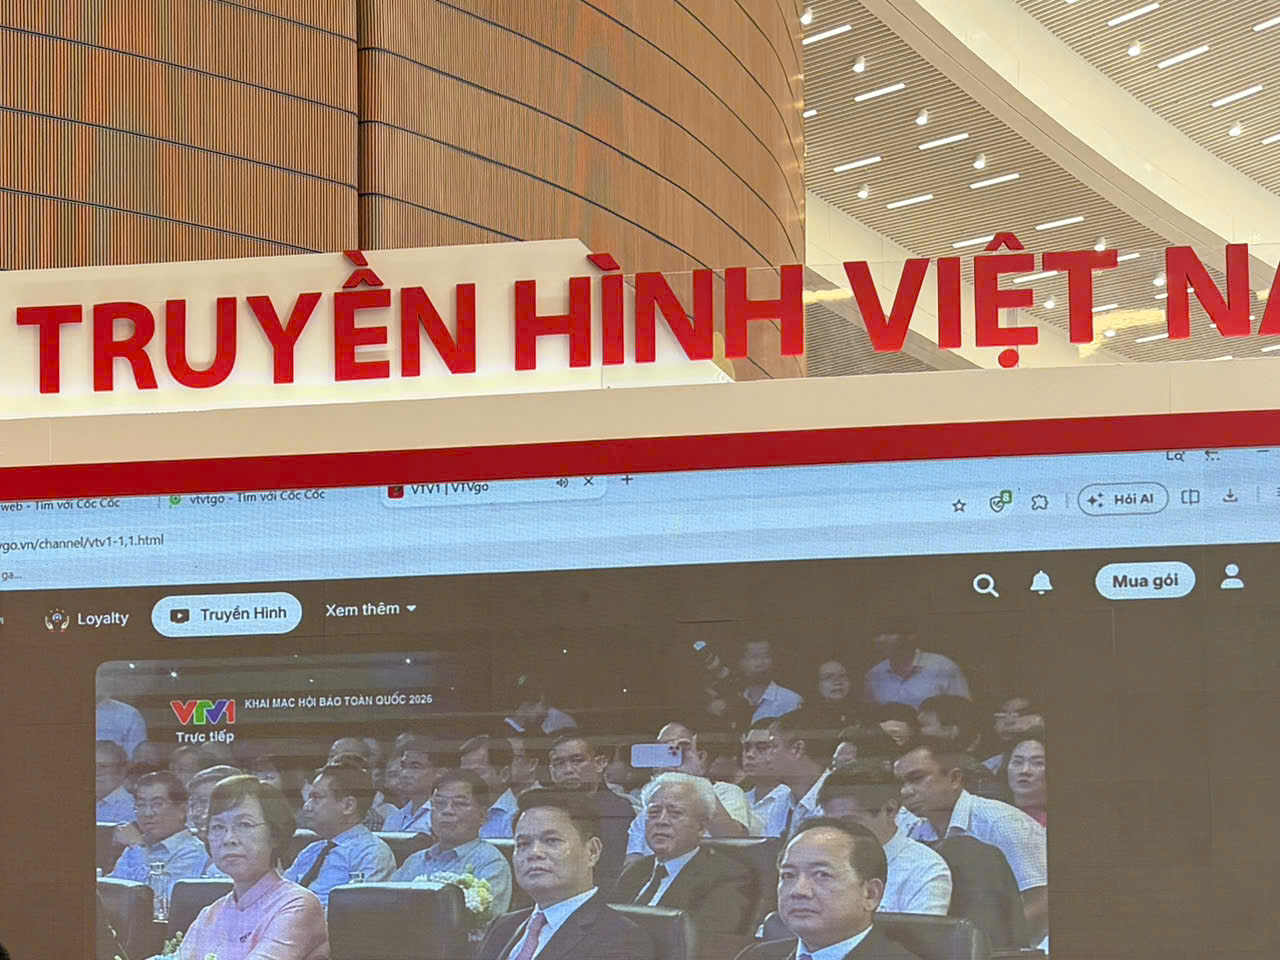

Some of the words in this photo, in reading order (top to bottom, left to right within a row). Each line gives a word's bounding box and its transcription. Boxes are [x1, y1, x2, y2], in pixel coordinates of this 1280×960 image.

[16, 249, 476, 394] TRUYỀN
[514, 252, 804, 371] HÌNH
[843, 232, 1118, 368] VIỆT
[1, 501, 23, 512] web
[1114, 493, 1137, 505] Hỏi
[1112, 574, 1148, 588] Mua
[1153, 572, 1179, 590] gói
[201, 604, 250, 622] Truyền
[253, 604, 287, 620] Hình
[326, 603, 358, 617] Xem
[362, 601, 400, 616] thêm
[78, 612, 129, 627] Loyalty
[245, 699, 270, 709] KHAI
[273, 698, 295, 711] MẠC
[298, 696, 316, 709] HỘI
[344, 694, 372, 706] TOÀN
[176, 731, 206, 745] Trực
[210, 729, 234, 745] tiếp
